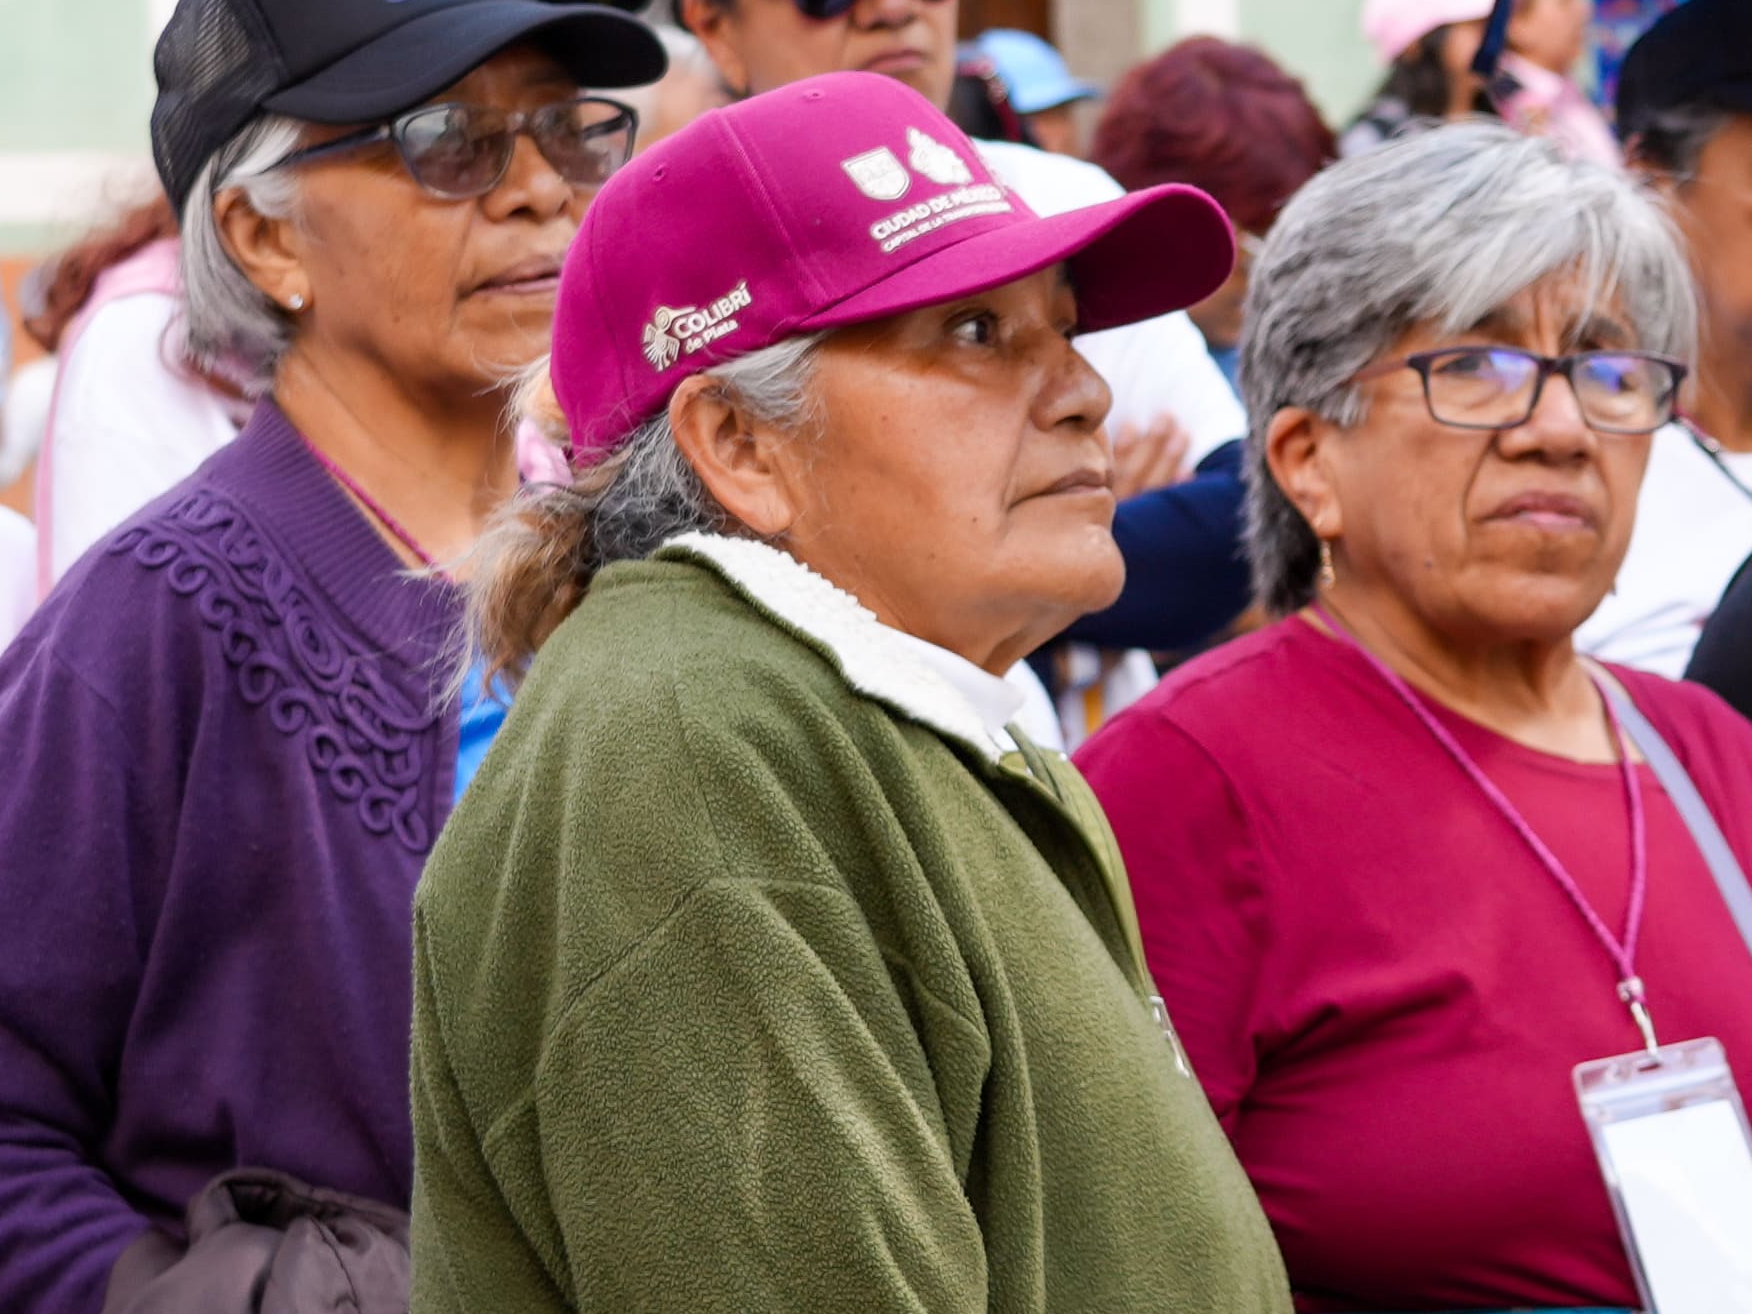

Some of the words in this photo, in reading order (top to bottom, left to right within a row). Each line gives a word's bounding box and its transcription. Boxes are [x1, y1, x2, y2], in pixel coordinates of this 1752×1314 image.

[871, 203, 931, 240] CIUDAD
[930, 194, 952, 214] DE
[673, 281, 751, 339] COLIBRÍ
[685, 337, 704, 354] de
[702, 320, 738, 343] Plata
